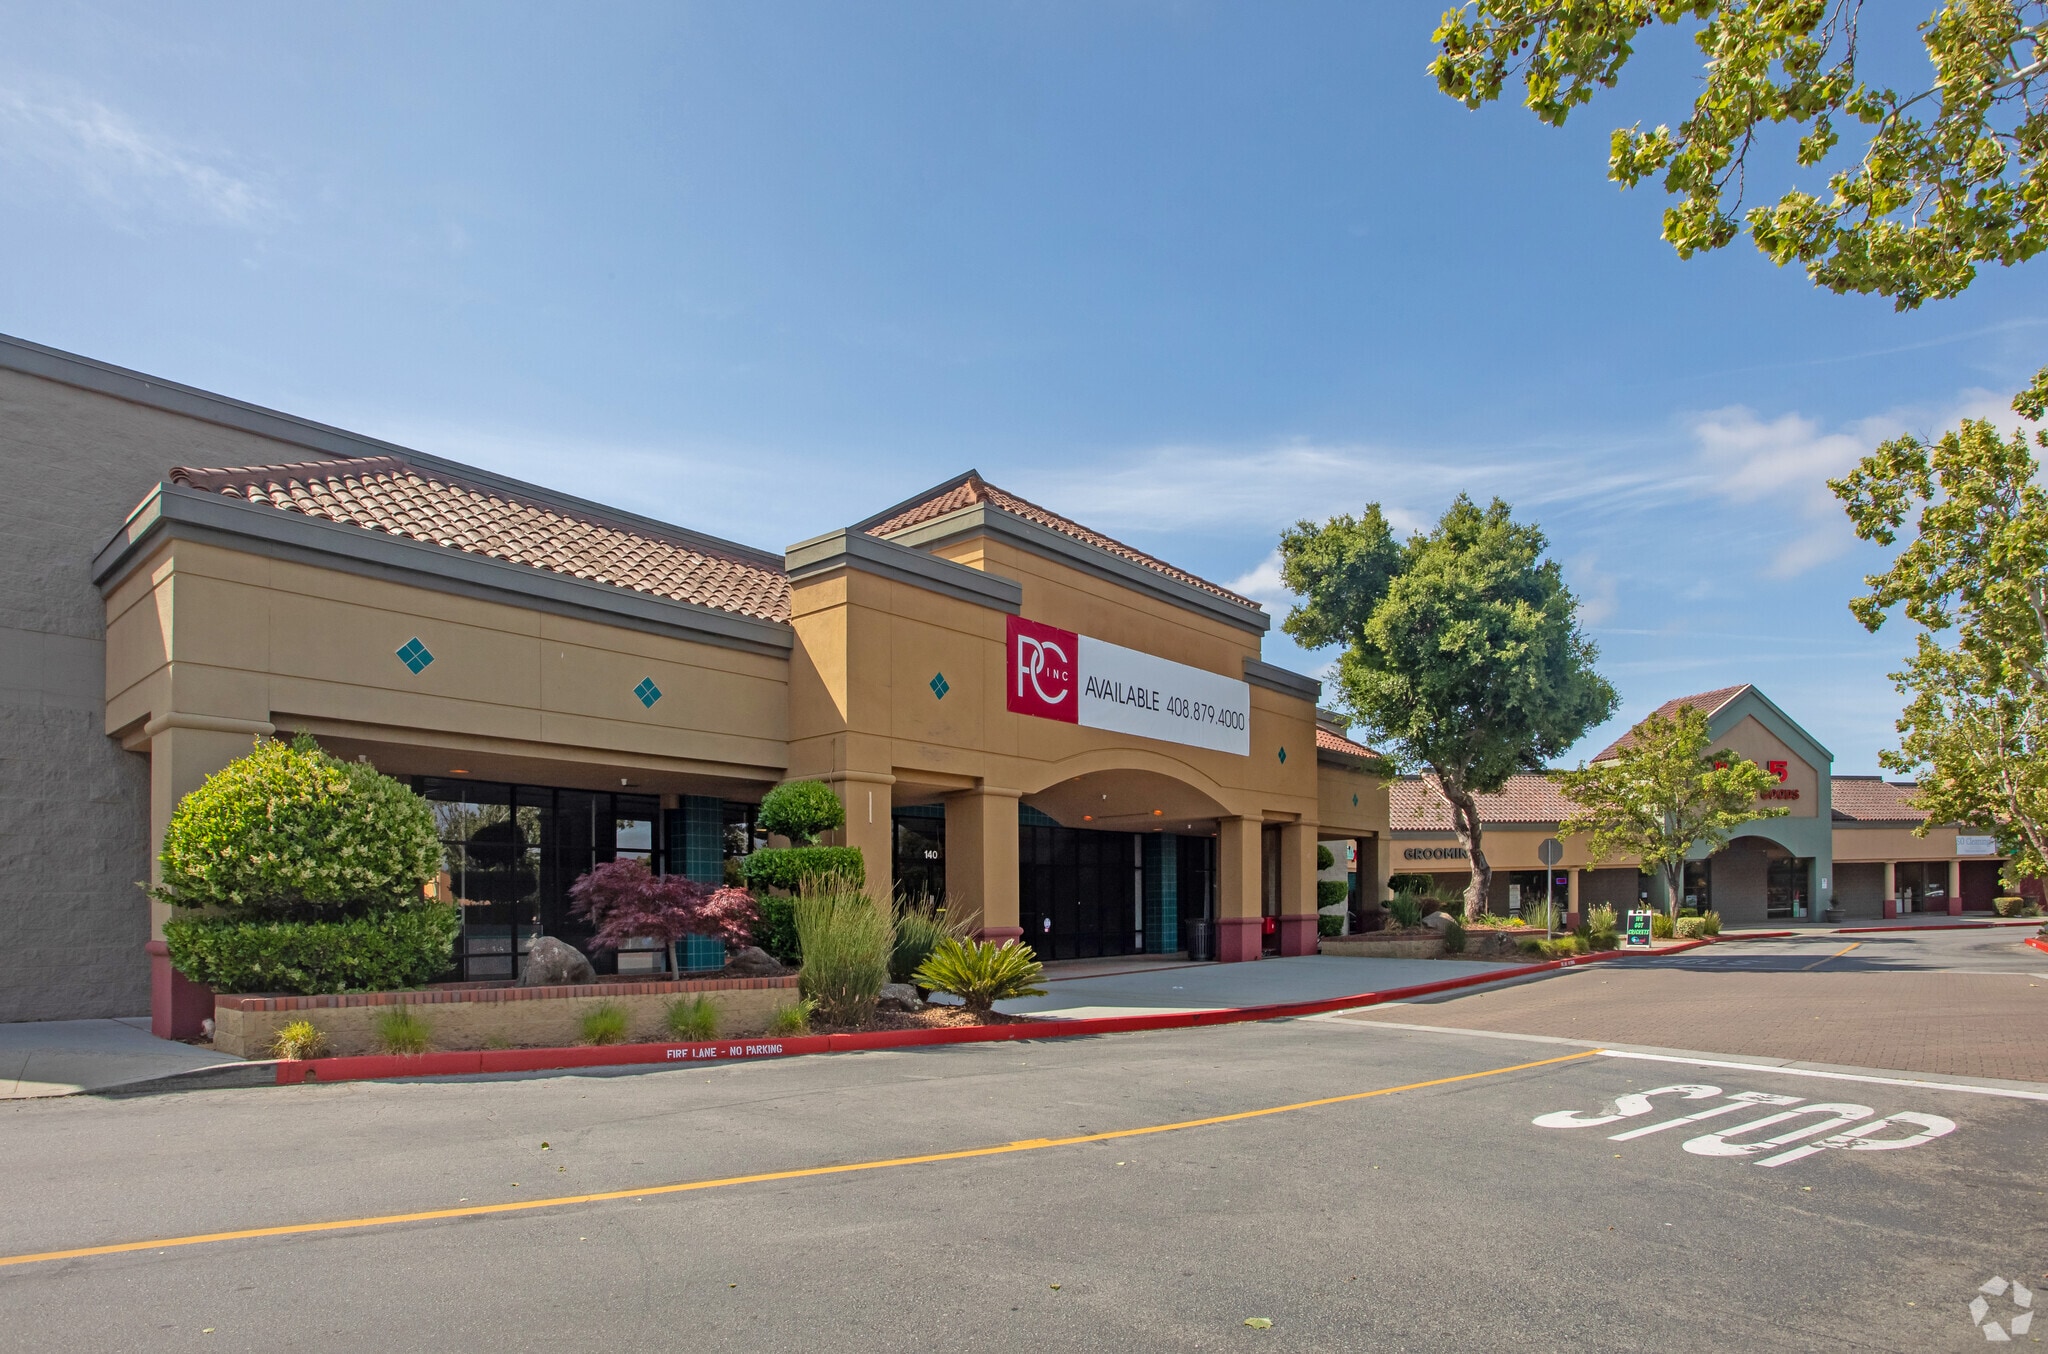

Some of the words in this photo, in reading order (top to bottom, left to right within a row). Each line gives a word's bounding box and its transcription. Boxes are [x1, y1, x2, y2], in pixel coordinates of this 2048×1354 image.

[1046, 667, 1069, 682] INC
[1085, 675, 1160, 711] AVAILABLE
[1166, 695, 1246, 731] 408.879.4000
[924, 850, 938, 859] 140
[1404, 847, 1469, 861] GROOMIN
[692, 1047, 717, 1058] LANE
[730, 1046, 743, 1056] NO
[746, 1044, 783, 1055] PARKING
[1532, 1084, 1957, 1168] STOP
